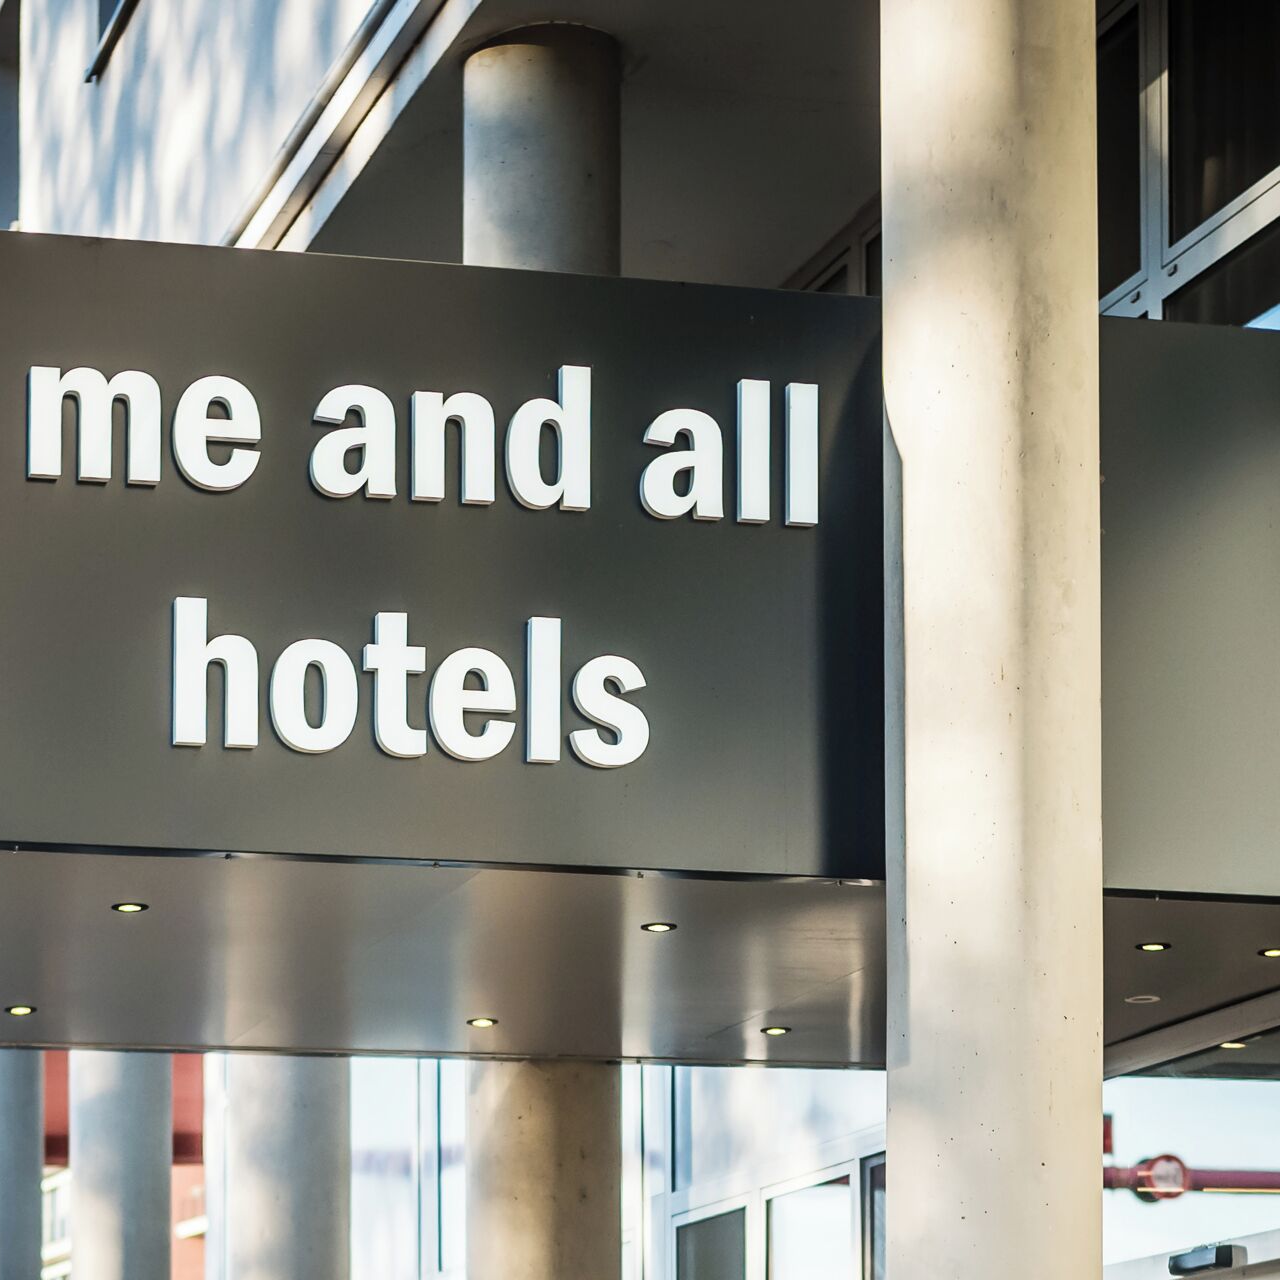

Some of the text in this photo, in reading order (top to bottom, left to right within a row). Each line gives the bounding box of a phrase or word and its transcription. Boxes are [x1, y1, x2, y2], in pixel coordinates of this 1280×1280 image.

[26, 364, 820, 528] me and all
[171, 596, 652, 770] hotels
